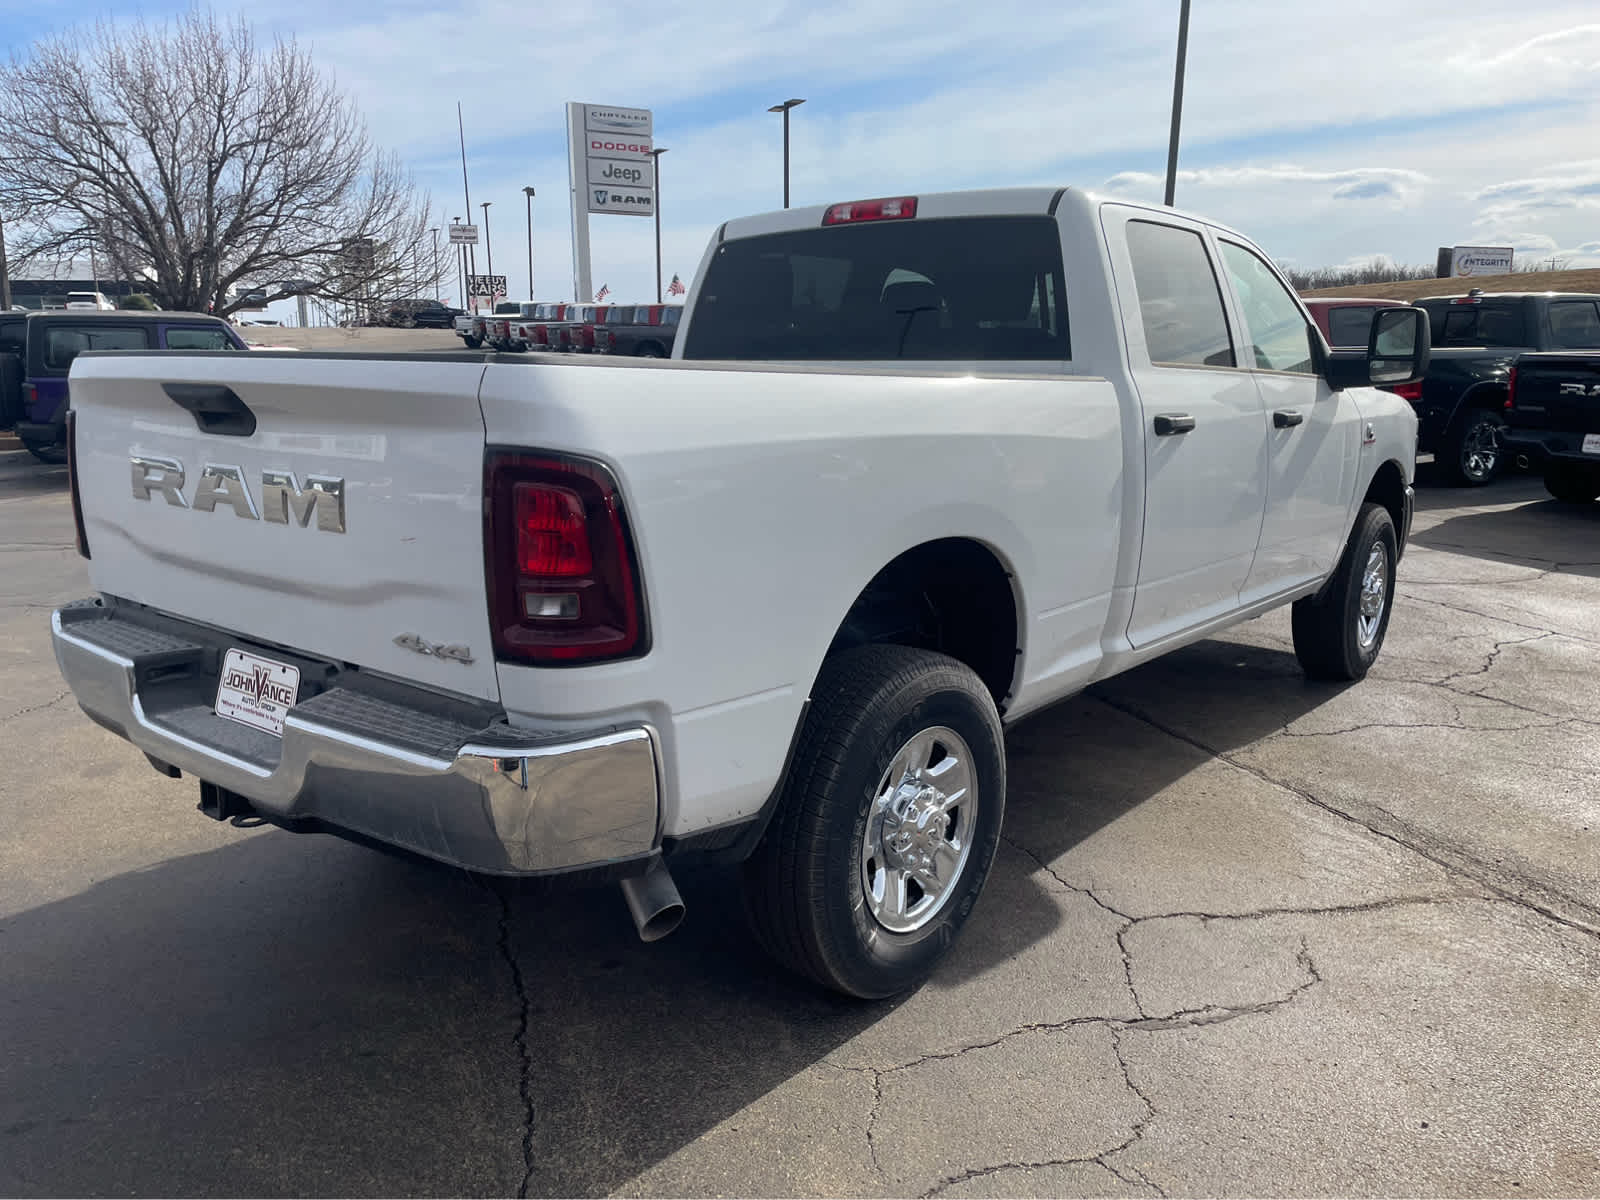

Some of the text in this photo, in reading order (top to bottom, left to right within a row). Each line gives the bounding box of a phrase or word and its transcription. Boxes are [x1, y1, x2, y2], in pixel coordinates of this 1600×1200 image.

[591, 141, 650, 153] DODGE
[602, 163, 641, 183] Jeep
[611, 194, 651, 205] RAM
[1464, 258, 1510, 267] INTEGRITY
[469, 284, 506, 295] CARS
[129, 454, 347, 534] RAM
[242, 696, 276, 712] AUTO GROUP
